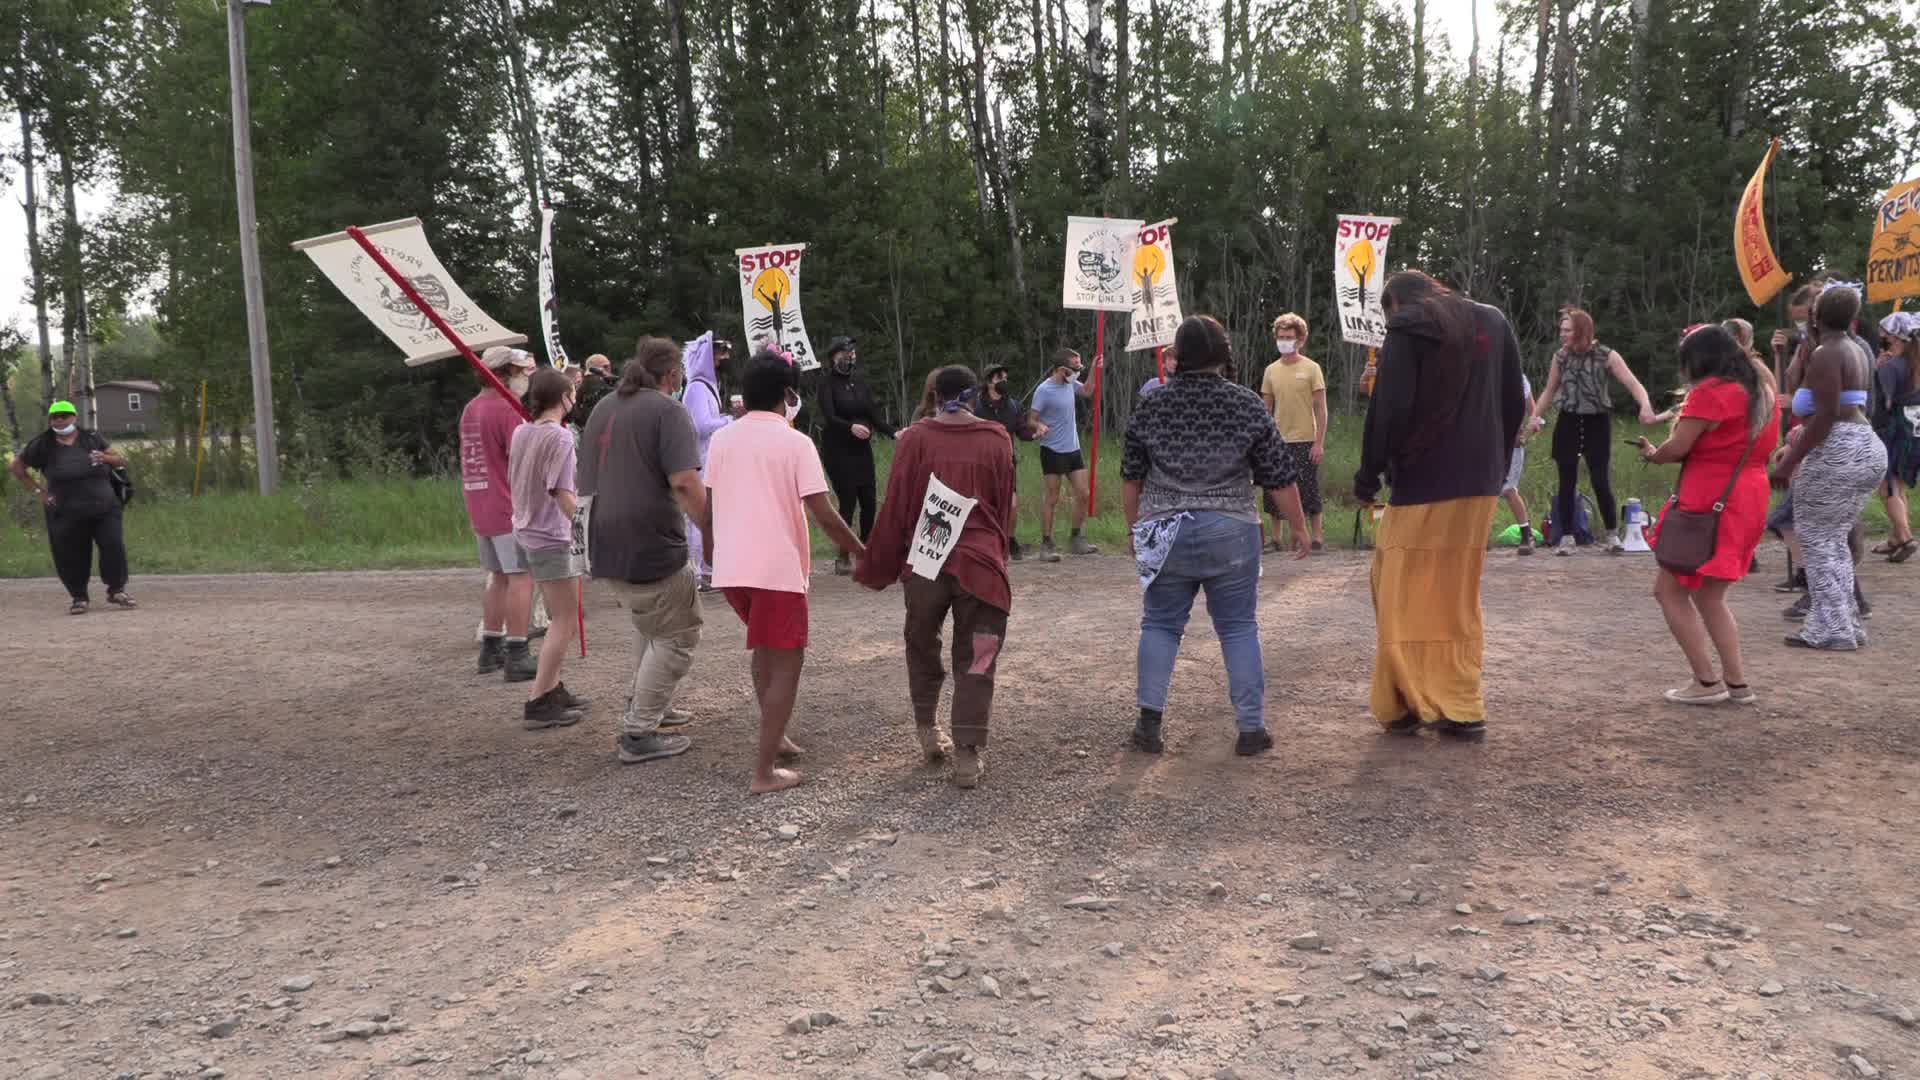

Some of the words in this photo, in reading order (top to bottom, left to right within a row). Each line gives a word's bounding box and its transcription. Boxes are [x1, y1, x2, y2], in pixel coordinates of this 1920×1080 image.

[1338, 220, 1391, 241] STOP
[741, 249, 800, 272] STOP
[1076, 292, 1096, 302] STOP
[1167, 312, 1178, 329] 3
[1344, 315, 1375, 334] LINE
[794, 341, 807, 356] 3
[927, 492, 962, 518] MIGIZI
[926, 548, 943, 561] FLY
